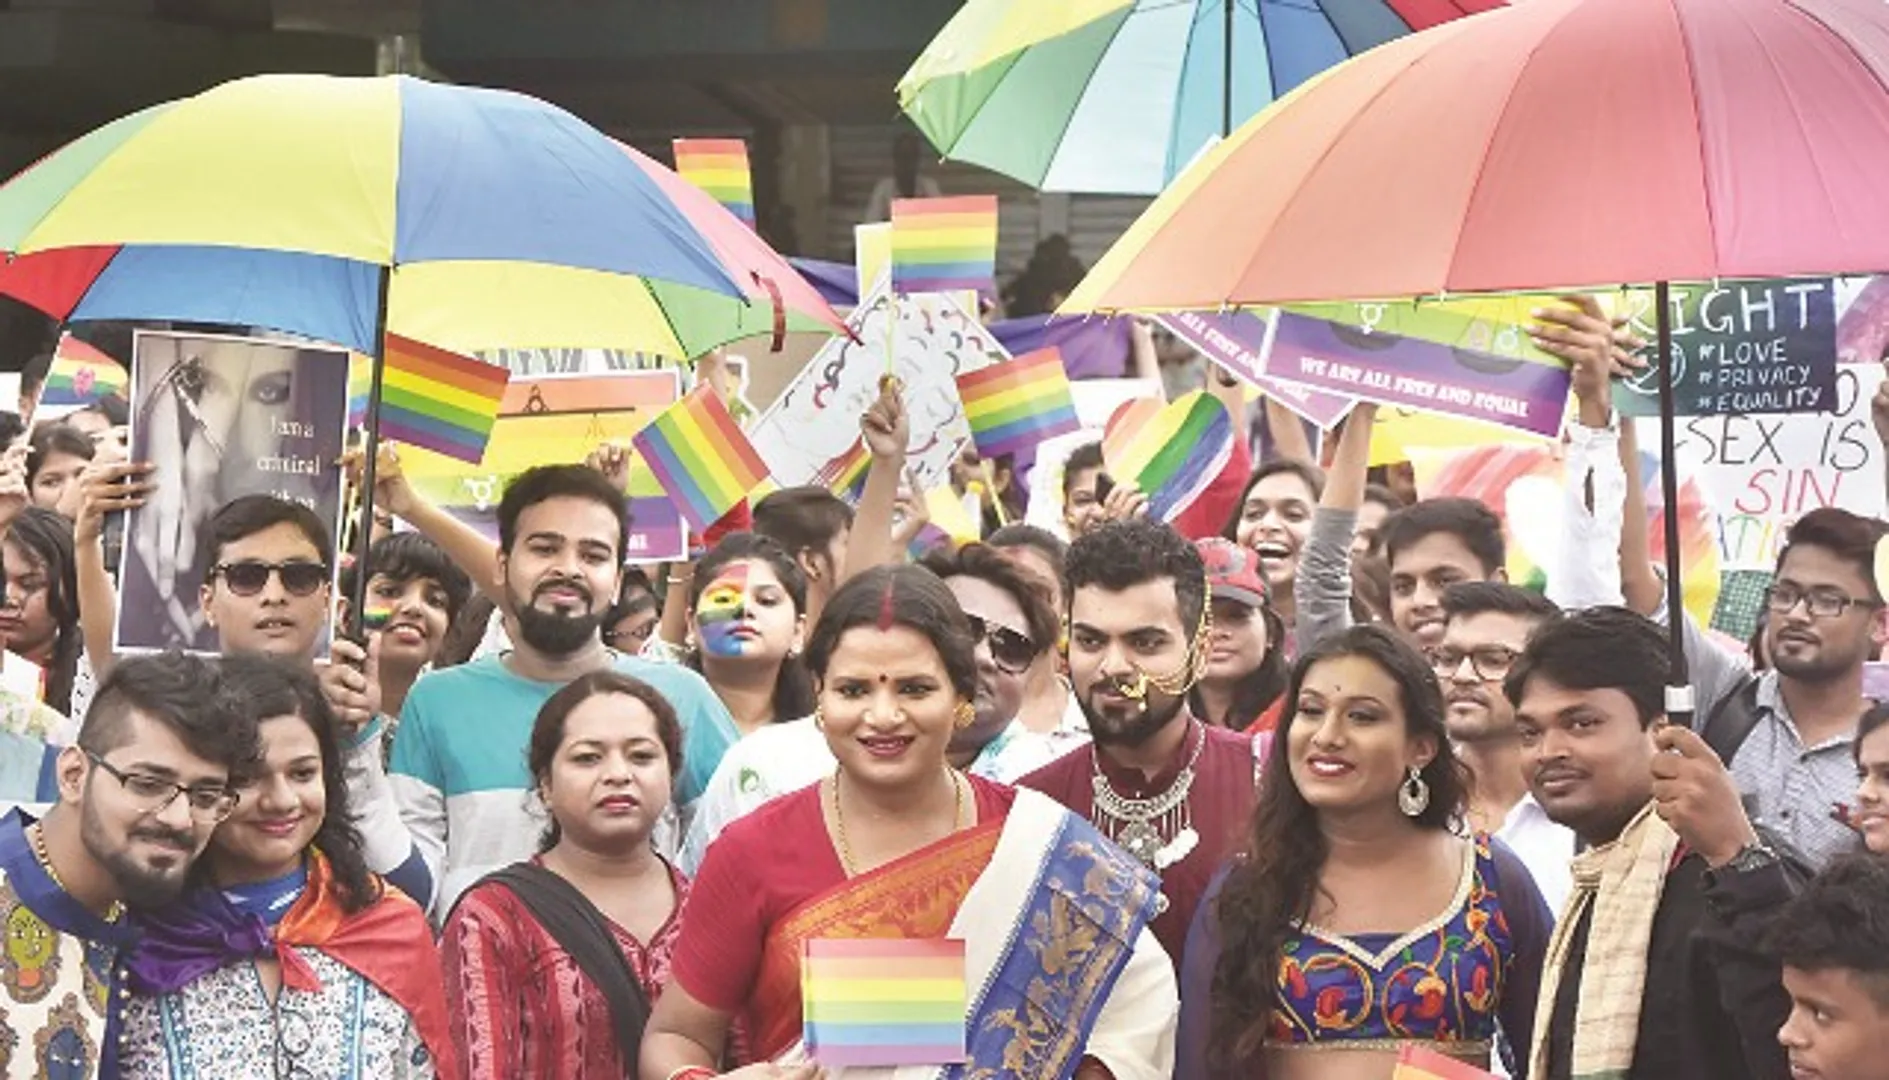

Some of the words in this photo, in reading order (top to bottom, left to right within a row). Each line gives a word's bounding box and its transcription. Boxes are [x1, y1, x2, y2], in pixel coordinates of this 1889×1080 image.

[1301, 357, 1328, 375] WE
[1328, 362, 1362, 383] ARE
[1362, 369, 1392, 391] ALL
[1394, 376, 1437, 396] FREE
[1436, 383, 1472, 406] AND
[1473, 391, 1529, 417] EQUAL
[1735, 468, 1843, 515] SIN
